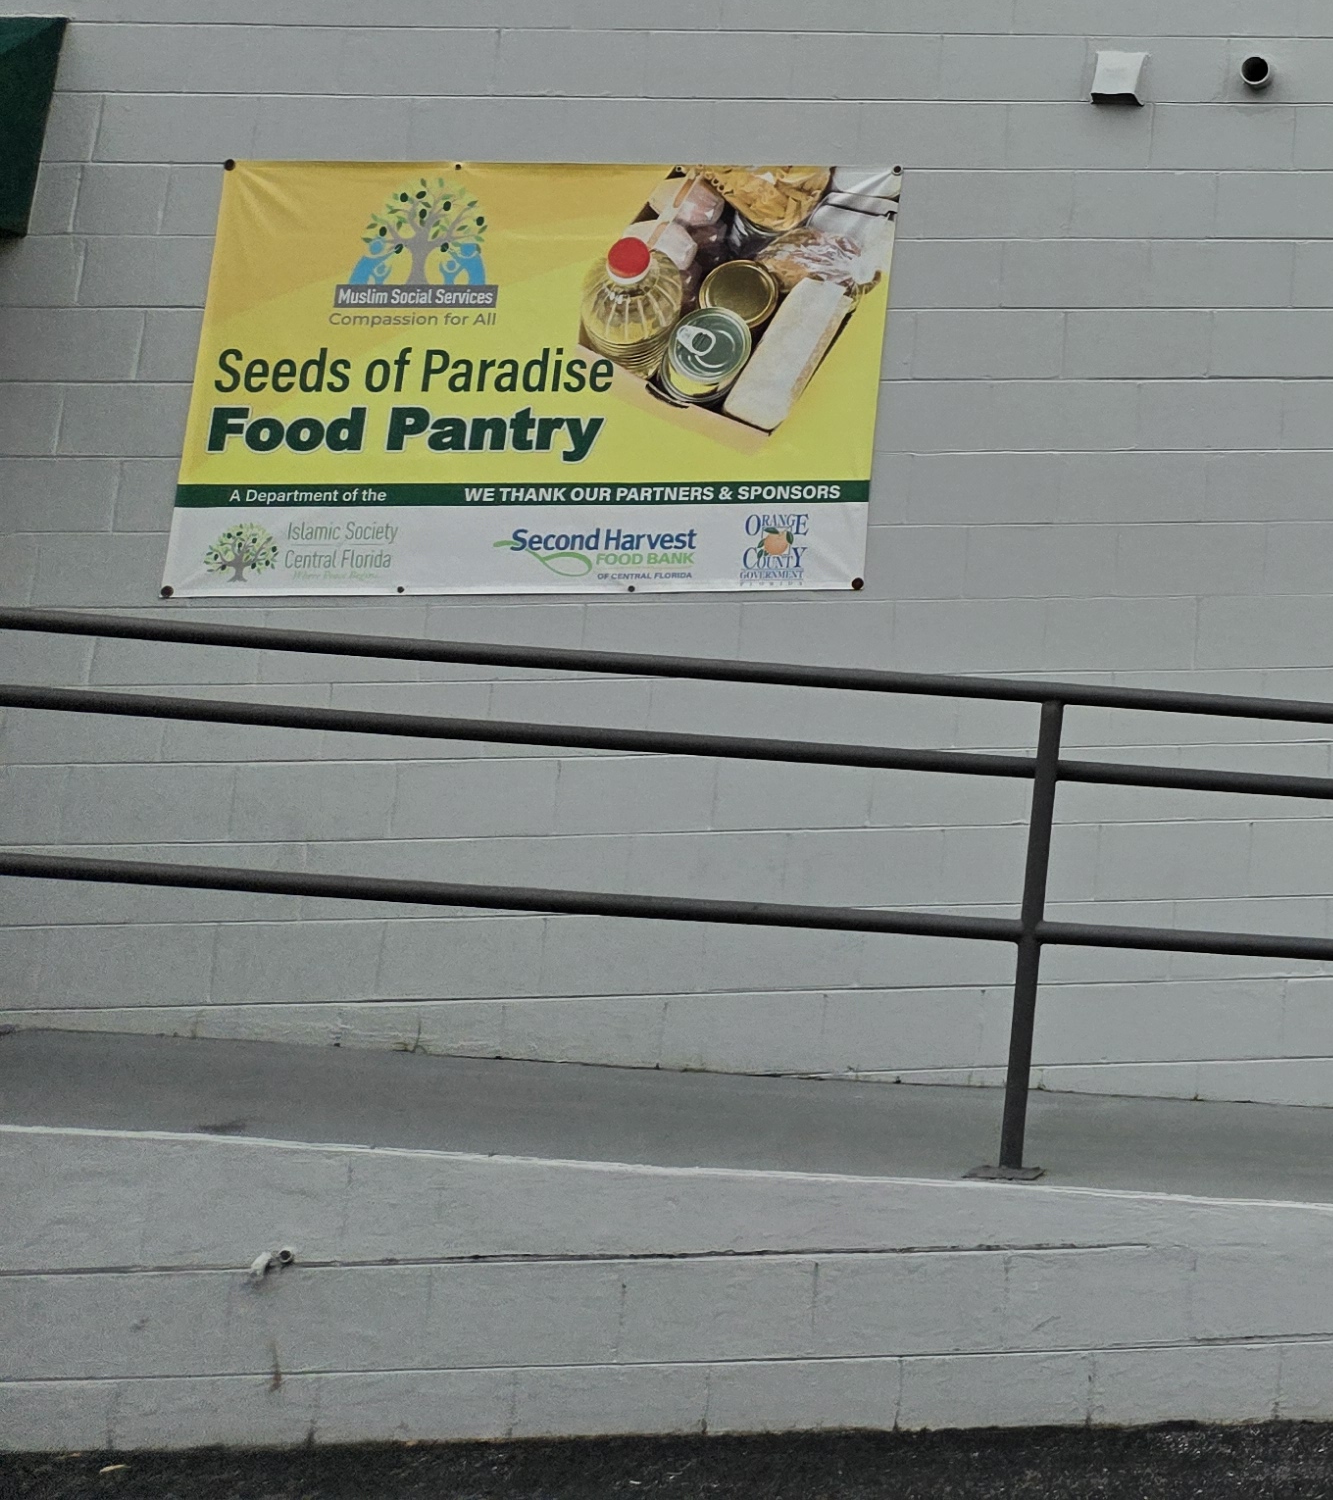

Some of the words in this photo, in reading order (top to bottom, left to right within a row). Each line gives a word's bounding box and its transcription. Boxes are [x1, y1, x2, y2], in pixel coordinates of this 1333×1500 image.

[338, 288, 387, 304] Muslim
[391, 288, 432, 304] Social
[435, 288, 493, 304] Services
[329, 312, 438, 327] Compassion
[444, 312, 469, 325] for
[473, 312, 496, 325] All
[214, 348, 351, 393] Seeds
[365, 347, 412, 393] of
[421, 348, 614, 393] Paradise
[206, 406, 368, 451] Food
[386, 406, 605, 462] Pantry
[229, 489, 241, 501] A
[246, 488, 340, 505] Department
[342, 488, 360, 501] of
[361, 488, 387, 501] the
[464, 488, 496, 502] WE
[499, 487, 567, 502] THANK
[570, 487, 611, 501] OUR
[615, 486, 715, 501] PARTNERS
[718, 486, 733, 500] &
[737, 485, 842, 500] SPONSORS
[287, 522, 341, 540] Islamic
[345, 521, 399, 544] Society
[745, 513, 809, 536] ORANGE
[510, 528, 601, 551] Second
[604, 528, 697, 550] Harvest
[284, 550, 337, 568] Central
[341, 549, 392, 568] Florida
[596, 553, 643, 565] FOOD
[646, 552, 694, 564] BANK
[743, 546, 808, 570] COUNTY
[740, 571, 804, 579] GOVERNMENT
